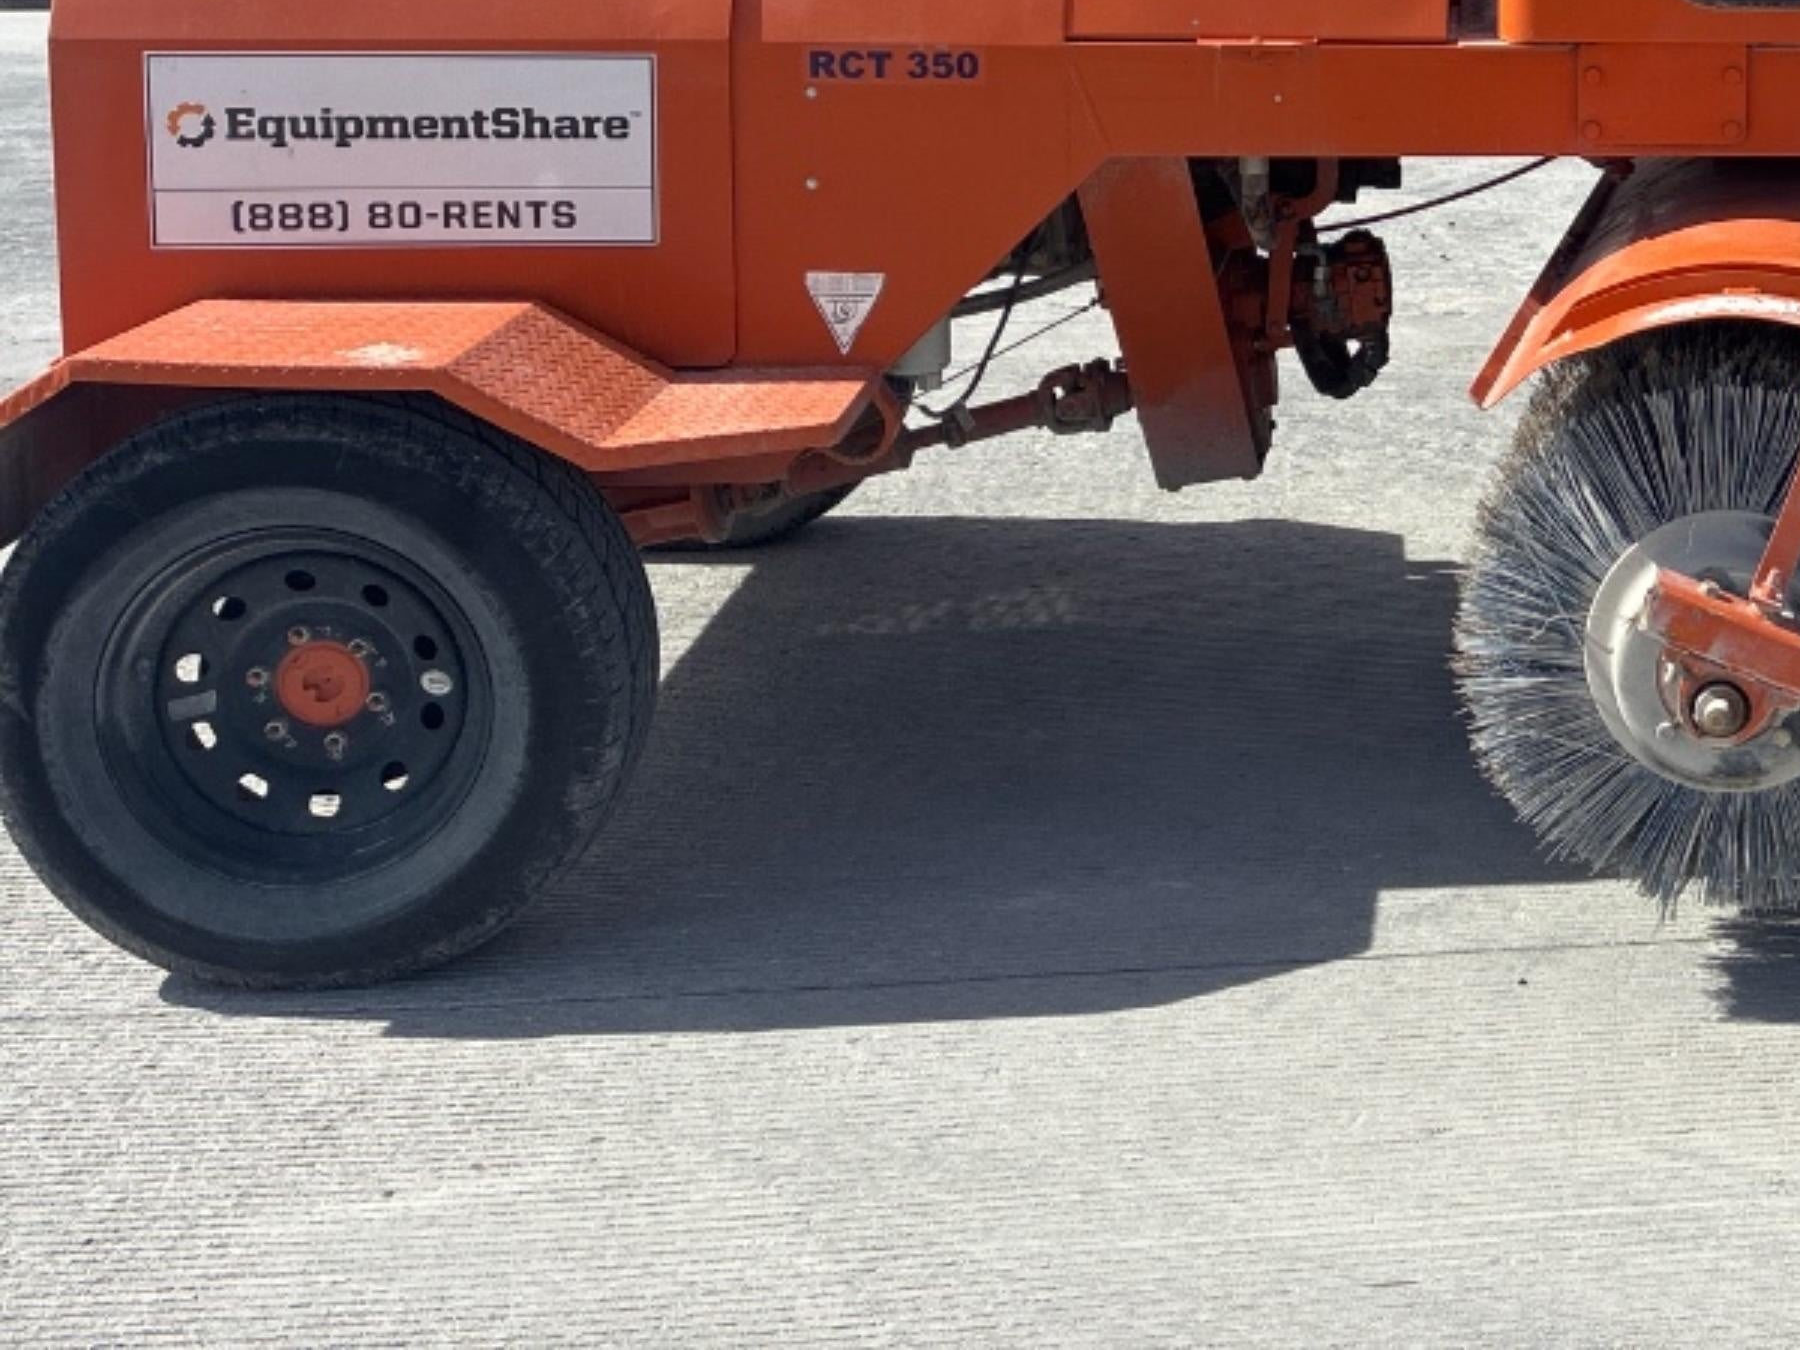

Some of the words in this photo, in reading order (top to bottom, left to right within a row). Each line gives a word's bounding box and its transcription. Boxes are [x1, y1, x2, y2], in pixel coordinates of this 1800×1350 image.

[809, 51, 892, 79] RCT
[907, 52, 979, 79] 350
[224, 107, 631, 148] EquipmentShare
[231, 200, 350, 231] (888)
[368, 201, 578, 230] 80-RENTS
